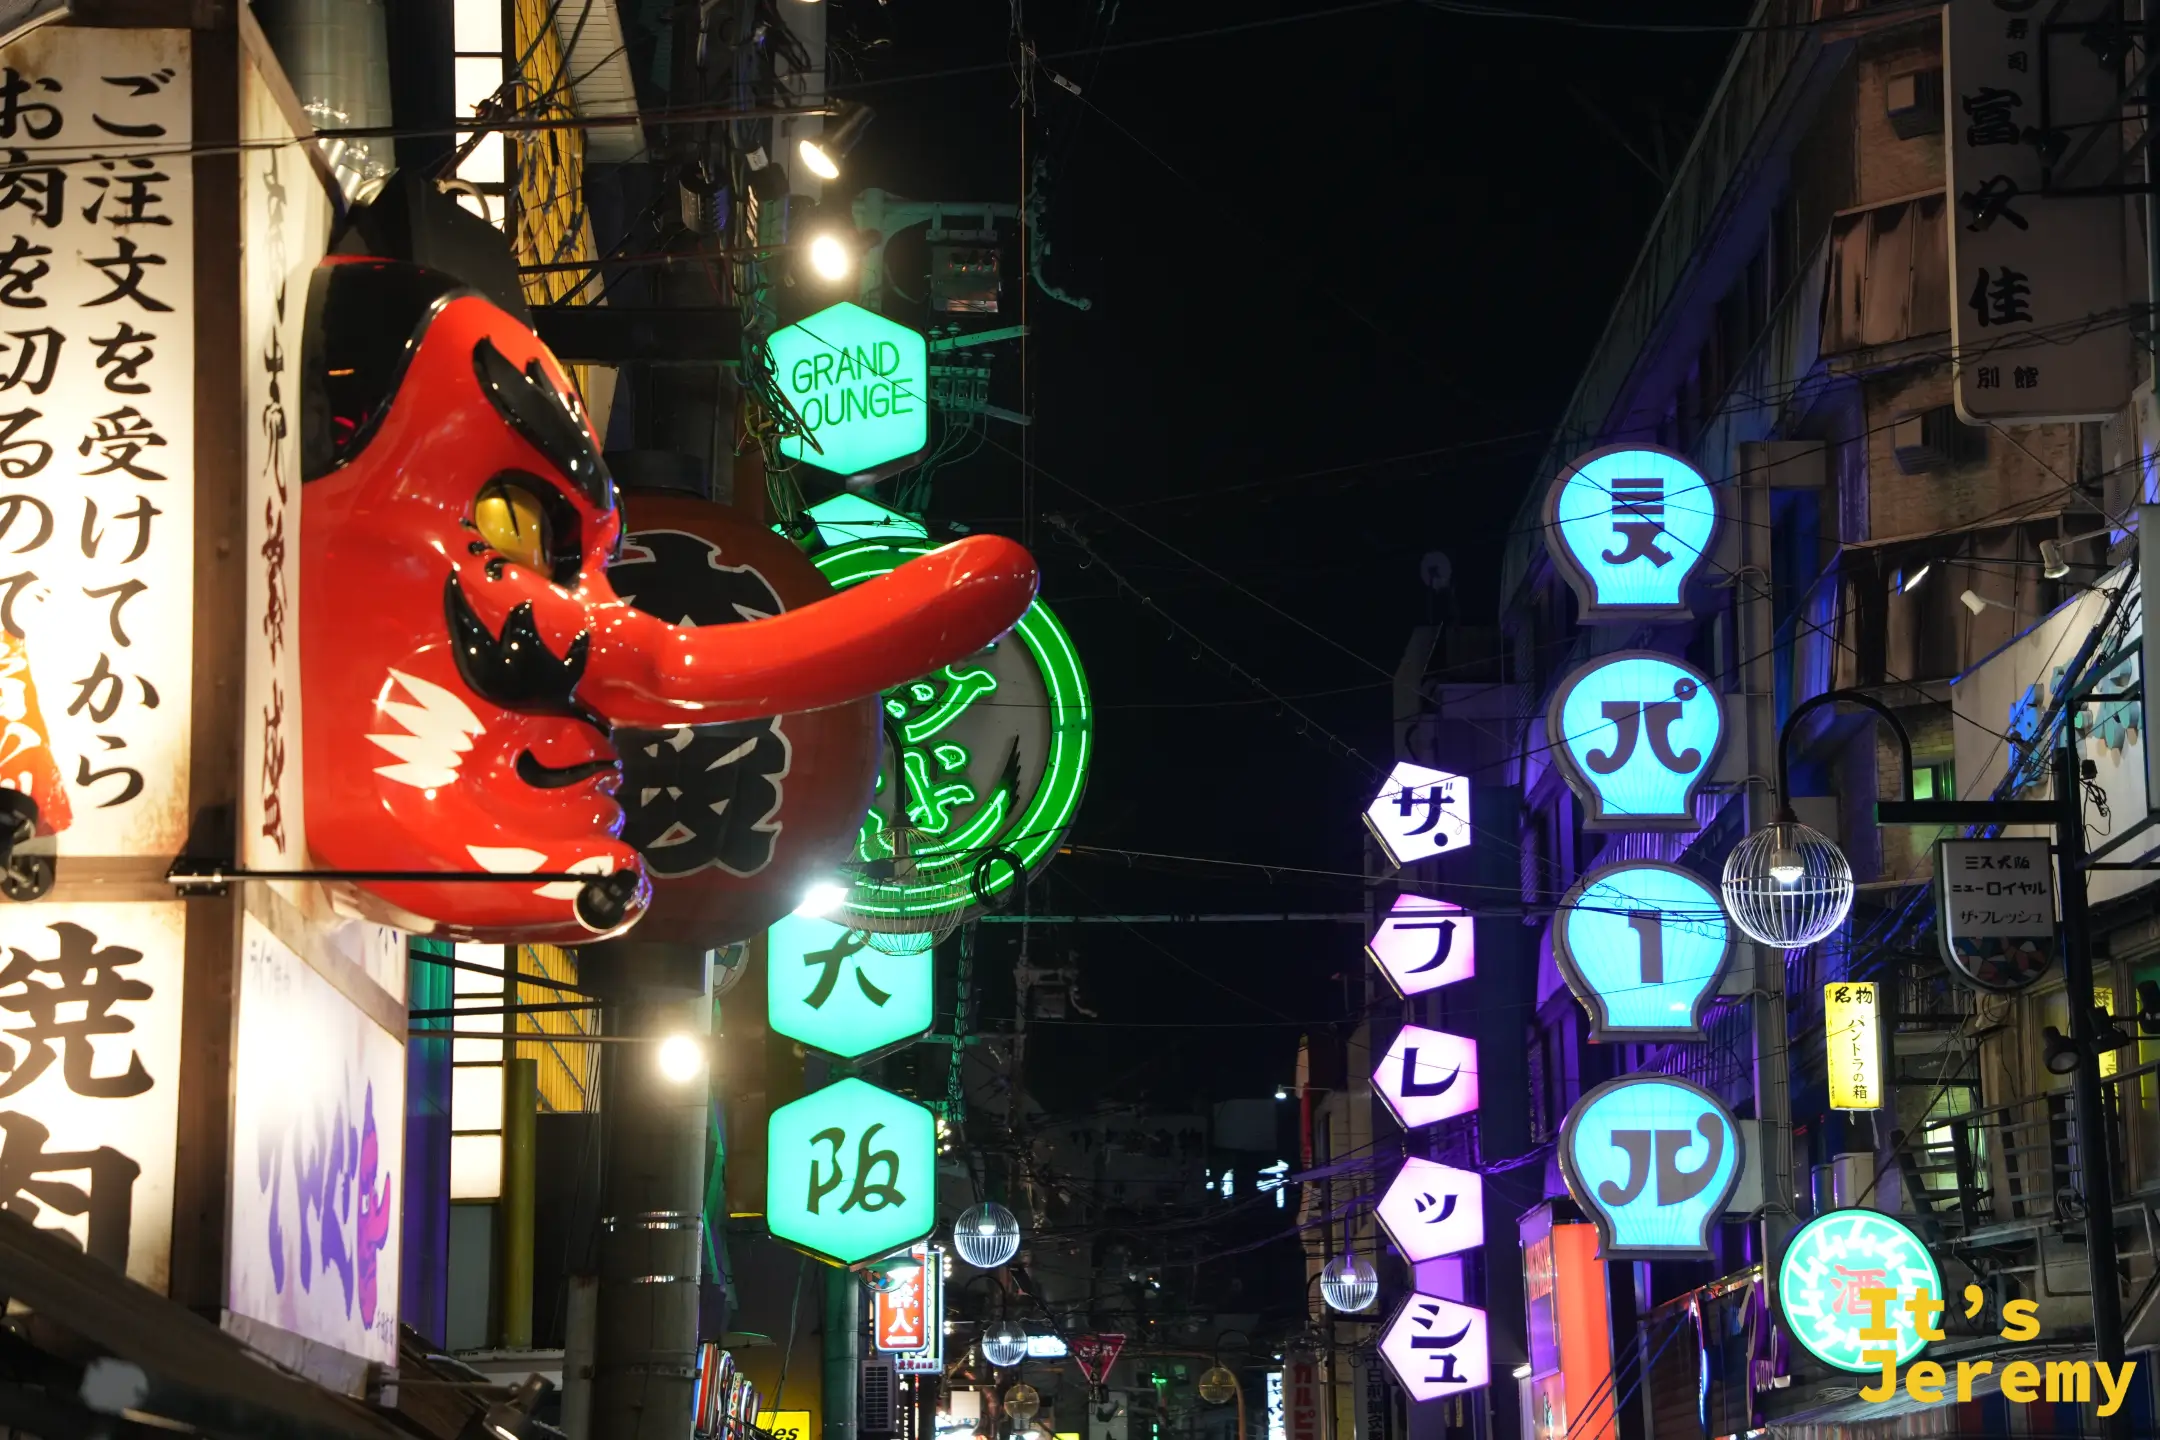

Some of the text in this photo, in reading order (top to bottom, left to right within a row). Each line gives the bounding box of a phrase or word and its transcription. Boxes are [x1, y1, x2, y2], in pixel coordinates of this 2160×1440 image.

[792, 341, 900, 394] GRAND
[1977, 366, 2039, 390] 別館
[801, 378, 913, 431] OUNGE
[66, 68, 176, 809] ご注文を受けてから
[1965, 855, 2030, 869] ミス大阪
[1952, 882, 2047, 895] ニューロイヤル
[1961, 909, 2043, 924] ザ・フレッシュ
[1834, 986, 1873, 1004] 名物
